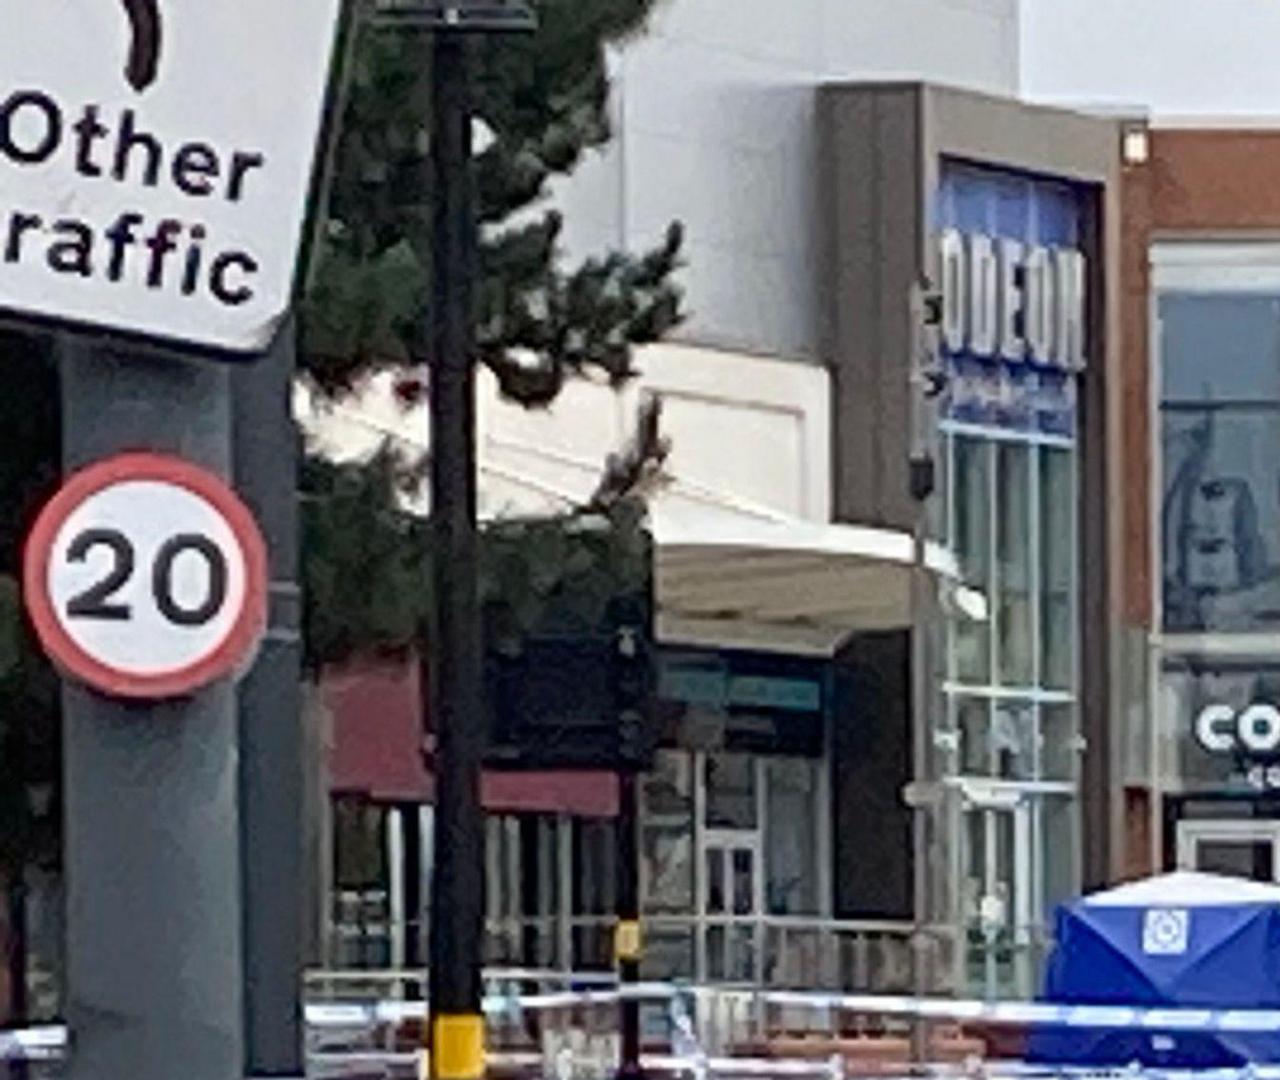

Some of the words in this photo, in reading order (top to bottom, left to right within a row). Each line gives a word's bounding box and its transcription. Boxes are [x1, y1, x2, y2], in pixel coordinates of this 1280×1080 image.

[0, 90, 264, 203] Other
[4, 211, 258, 306] raffic
[942, 228, 1087, 370] ODEON
[65, 528, 229, 626] 20
